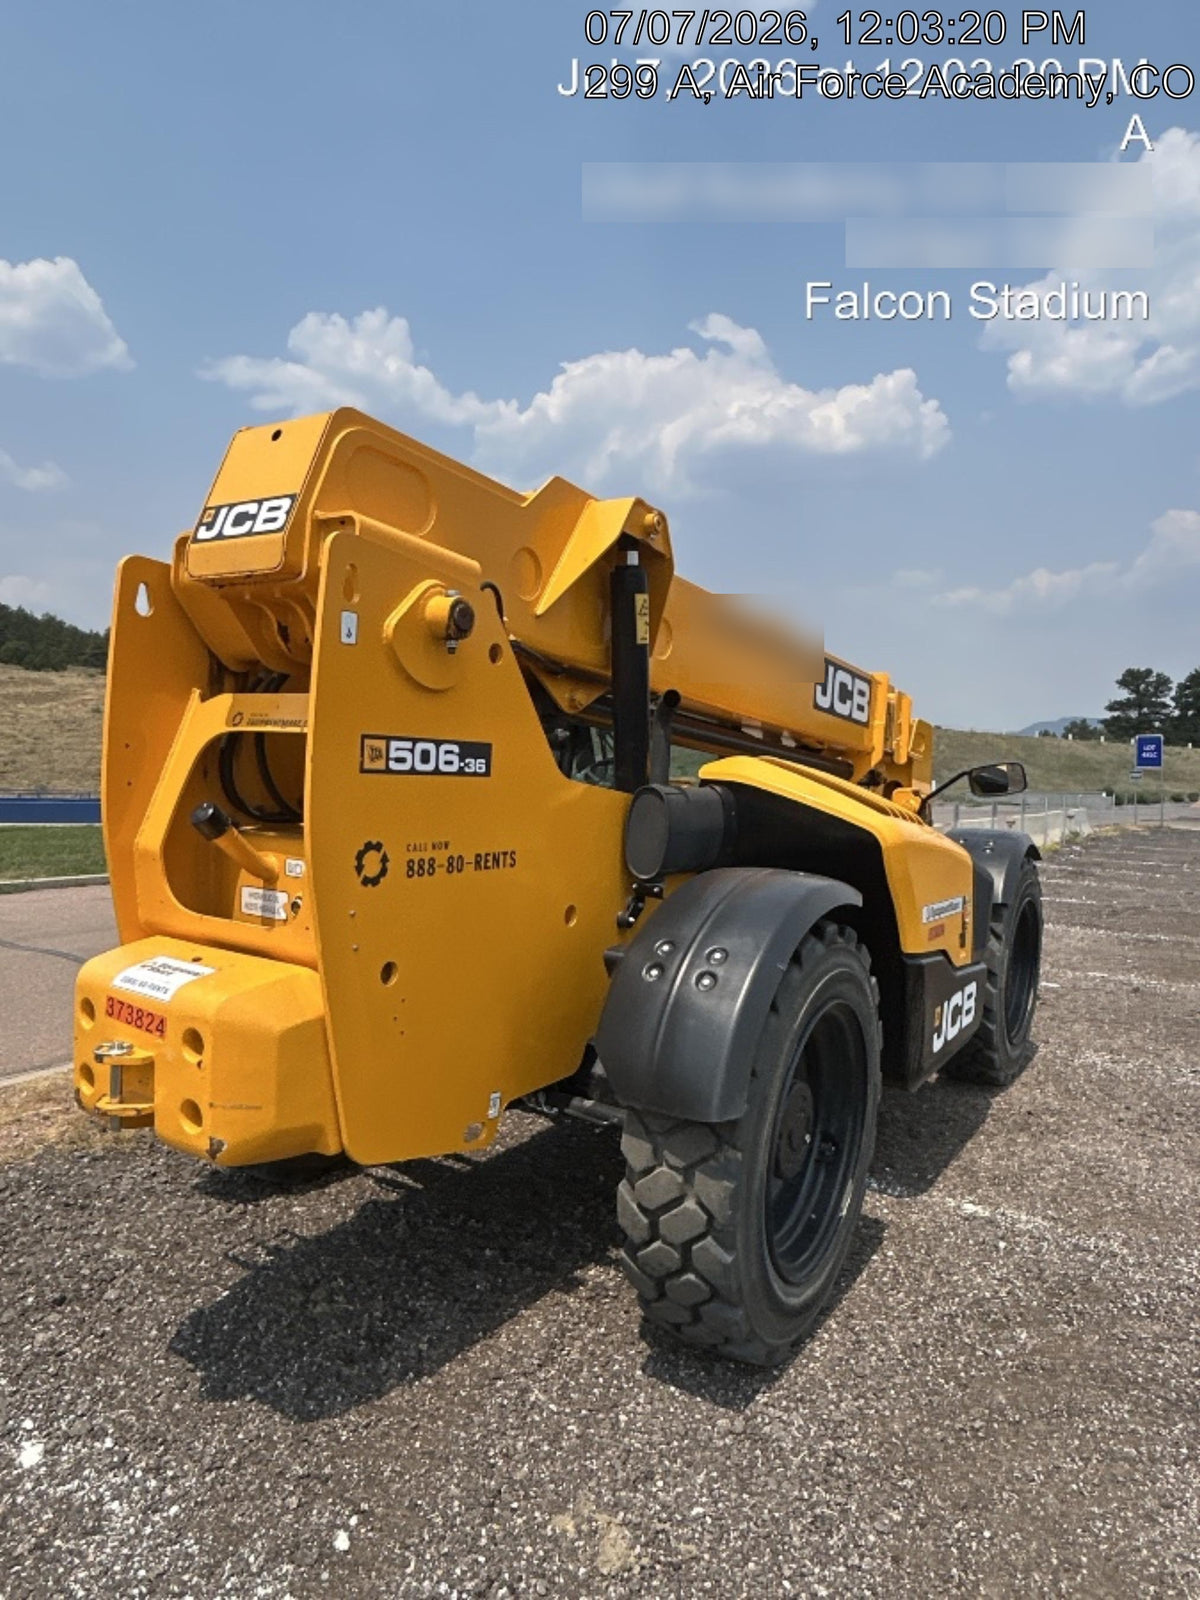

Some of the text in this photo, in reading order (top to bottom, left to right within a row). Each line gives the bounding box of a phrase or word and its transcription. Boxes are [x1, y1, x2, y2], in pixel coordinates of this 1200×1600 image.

[196, 497, 292, 540] JCB
[815, 664, 871, 723] JCB
[406, 841, 450, 853] CALL NOW
[406, 850, 517, 878] 888-80-RENTS
[105, 996, 166, 1034] 373824
[932, 981, 977, 1053] JCB
